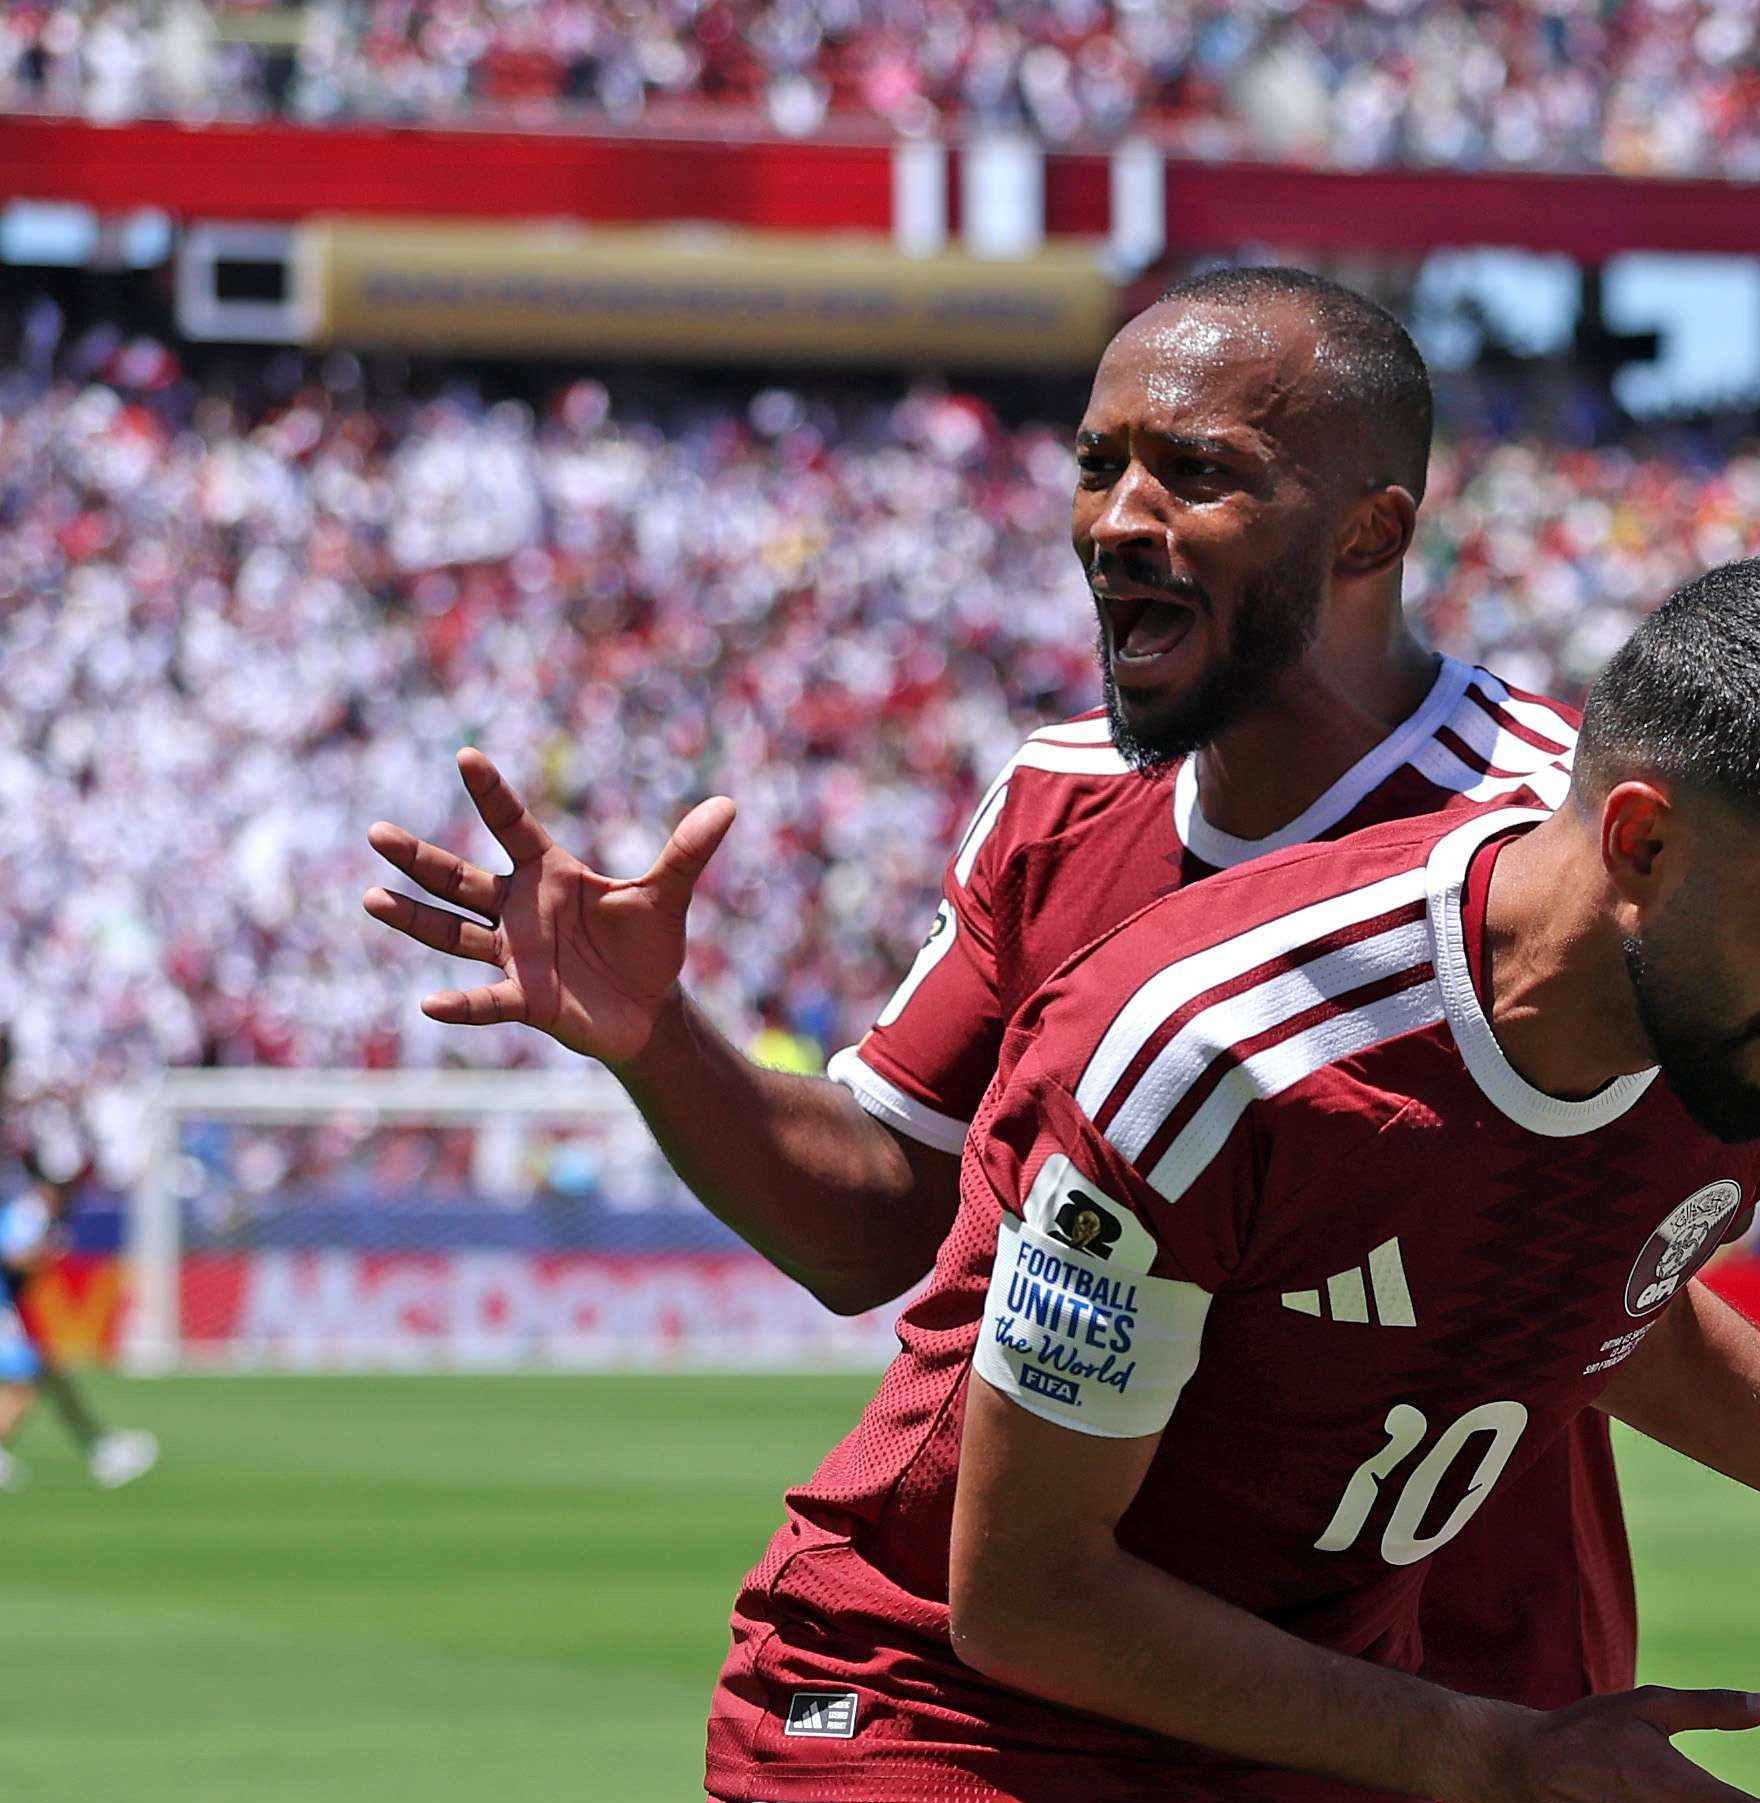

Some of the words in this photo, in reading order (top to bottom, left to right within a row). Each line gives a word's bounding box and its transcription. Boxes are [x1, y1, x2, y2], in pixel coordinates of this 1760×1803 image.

[1007, 1272, 1135, 1353] UNITES
[1017, 1241, 1138, 1313] FOOTBALL
[995, 1316, 1032, 1354] the
[1037, 1334, 1136, 1393] World
[1023, 1368, 1075, 1401] FIFA
[1313, 1400, 1528, 1566] 10
